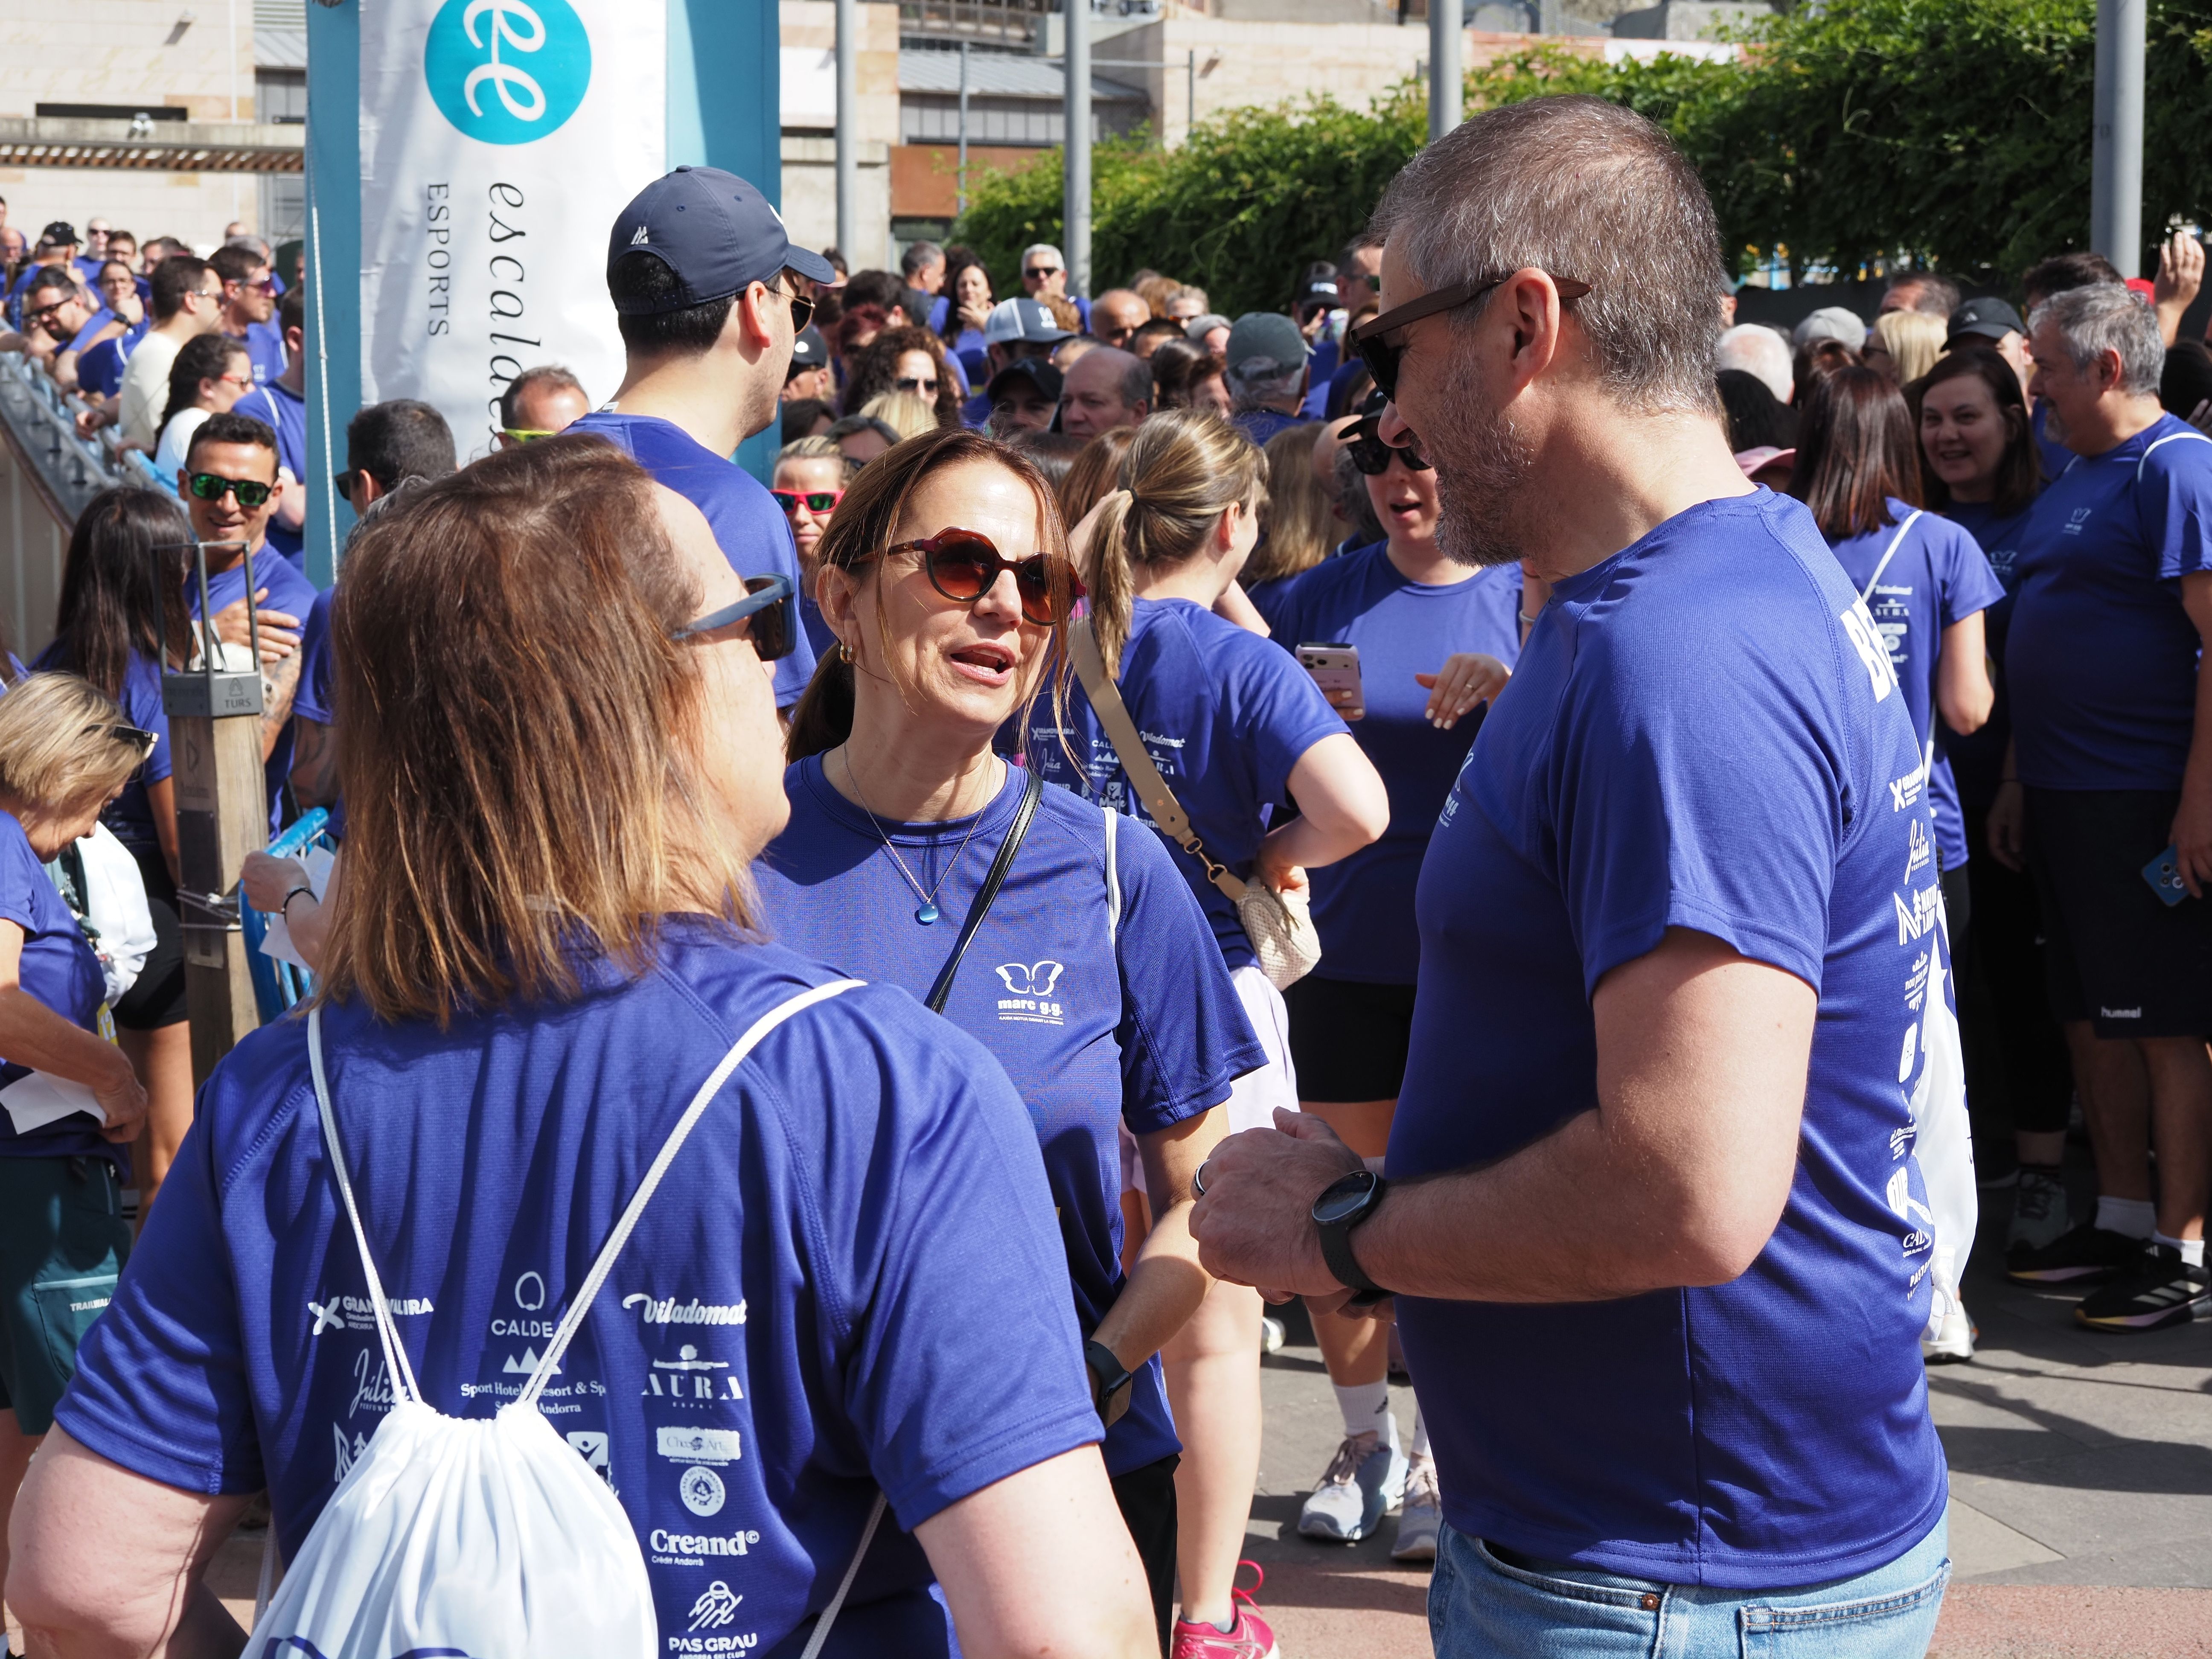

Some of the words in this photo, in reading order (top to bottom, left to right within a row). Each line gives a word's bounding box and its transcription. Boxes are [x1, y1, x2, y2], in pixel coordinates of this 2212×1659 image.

[428, 182, 450, 336] ESPORTS
[1139, 731, 1185, 748] Viladomat
[998, 999, 1036, 1010] marc
[2101, 1006, 2142, 1019] hummel
[623, 1293, 747, 1325] Viladomat
[491, 1319, 554, 1338] CALDE
[461, 1383, 492, 1398] Sport
[495, 1382, 524, 1396] Hotel
[540, 1385, 572, 1397] esort
[575, 1382, 587, 1394] &
[590, 1380, 607, 1397] Sp
[641, 1374, 744, 1400] AURA
[539, 1402, 582, 1415] Andorra
[669, 1637, 703, 1653] PAS
[704, 1633, 757, 1652] GRAU
